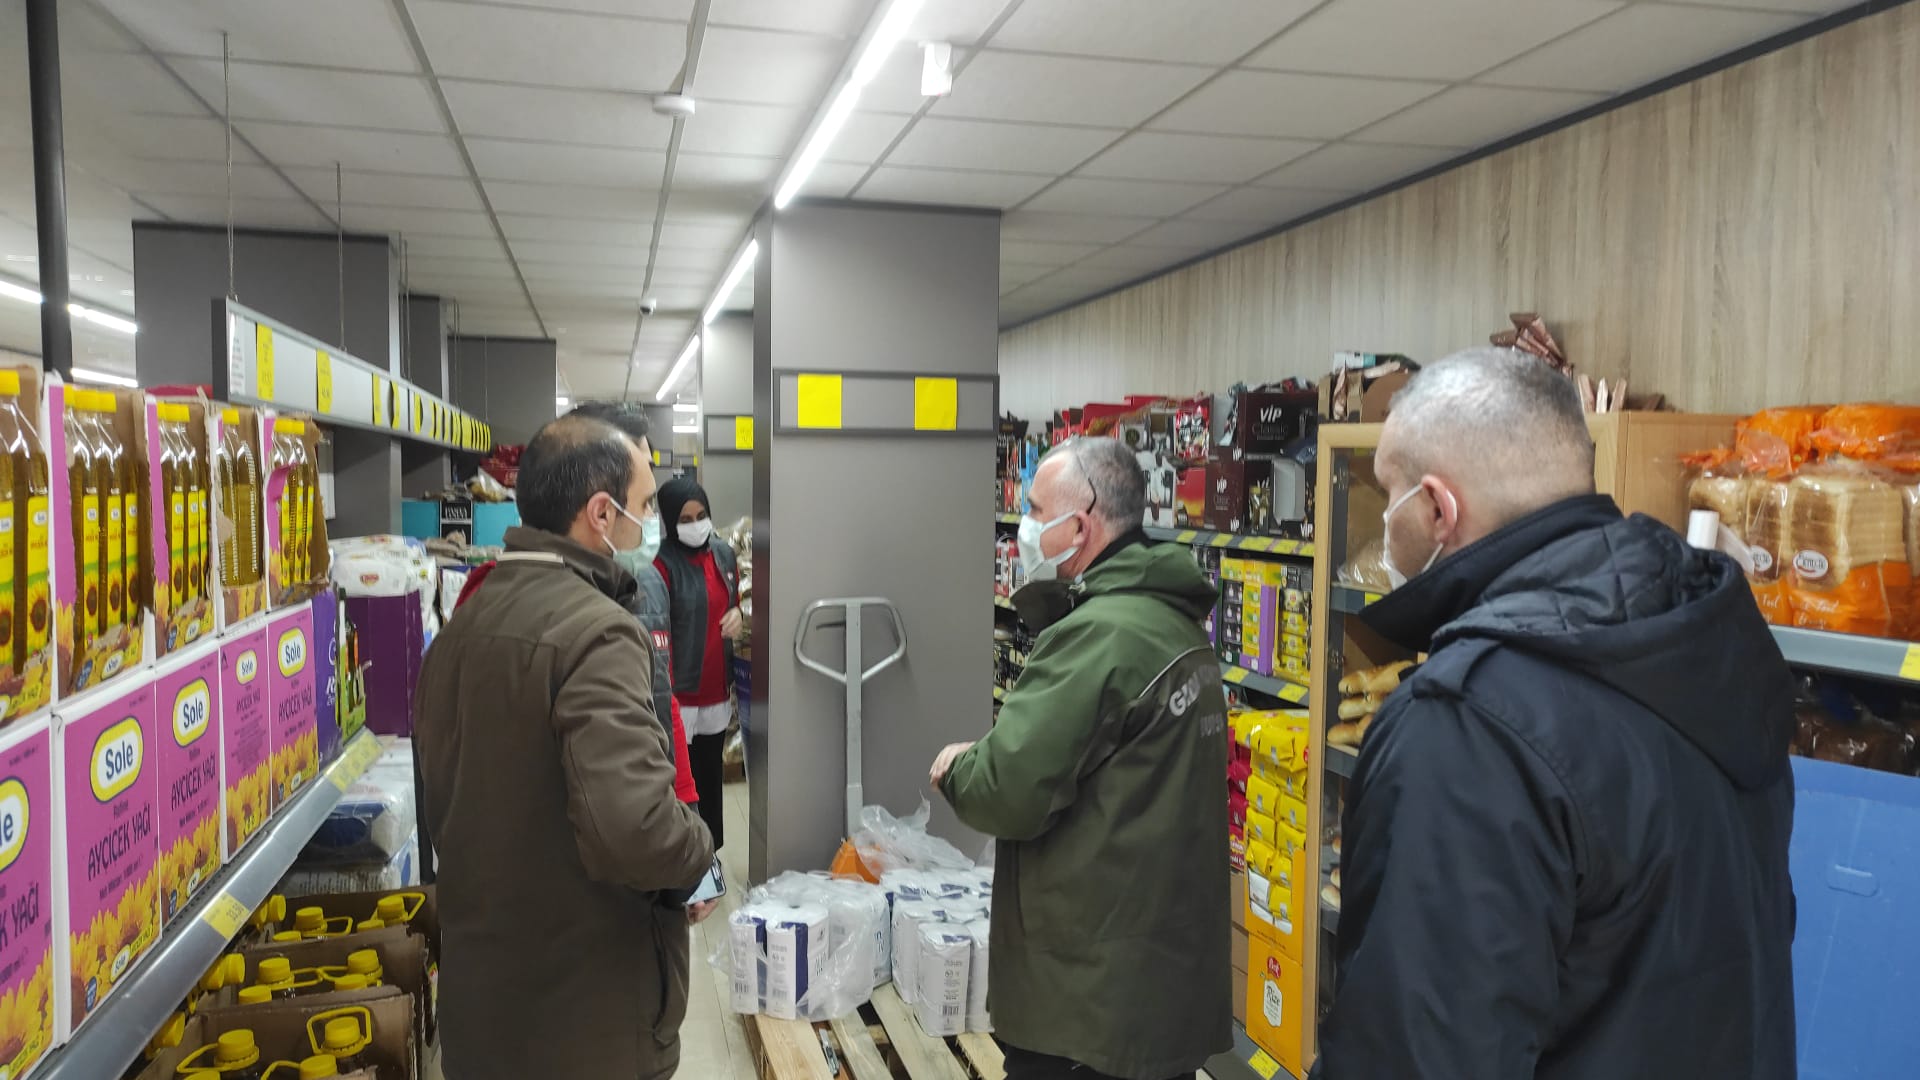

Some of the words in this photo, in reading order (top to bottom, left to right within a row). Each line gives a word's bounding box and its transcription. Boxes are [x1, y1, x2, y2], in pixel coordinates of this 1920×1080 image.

[1260, 404, 1282, 423] VIP
[284, 641, 302, 664] Sole
[183, 697, 204, 729] Sole
[105, 739, 134, 781] Sole
